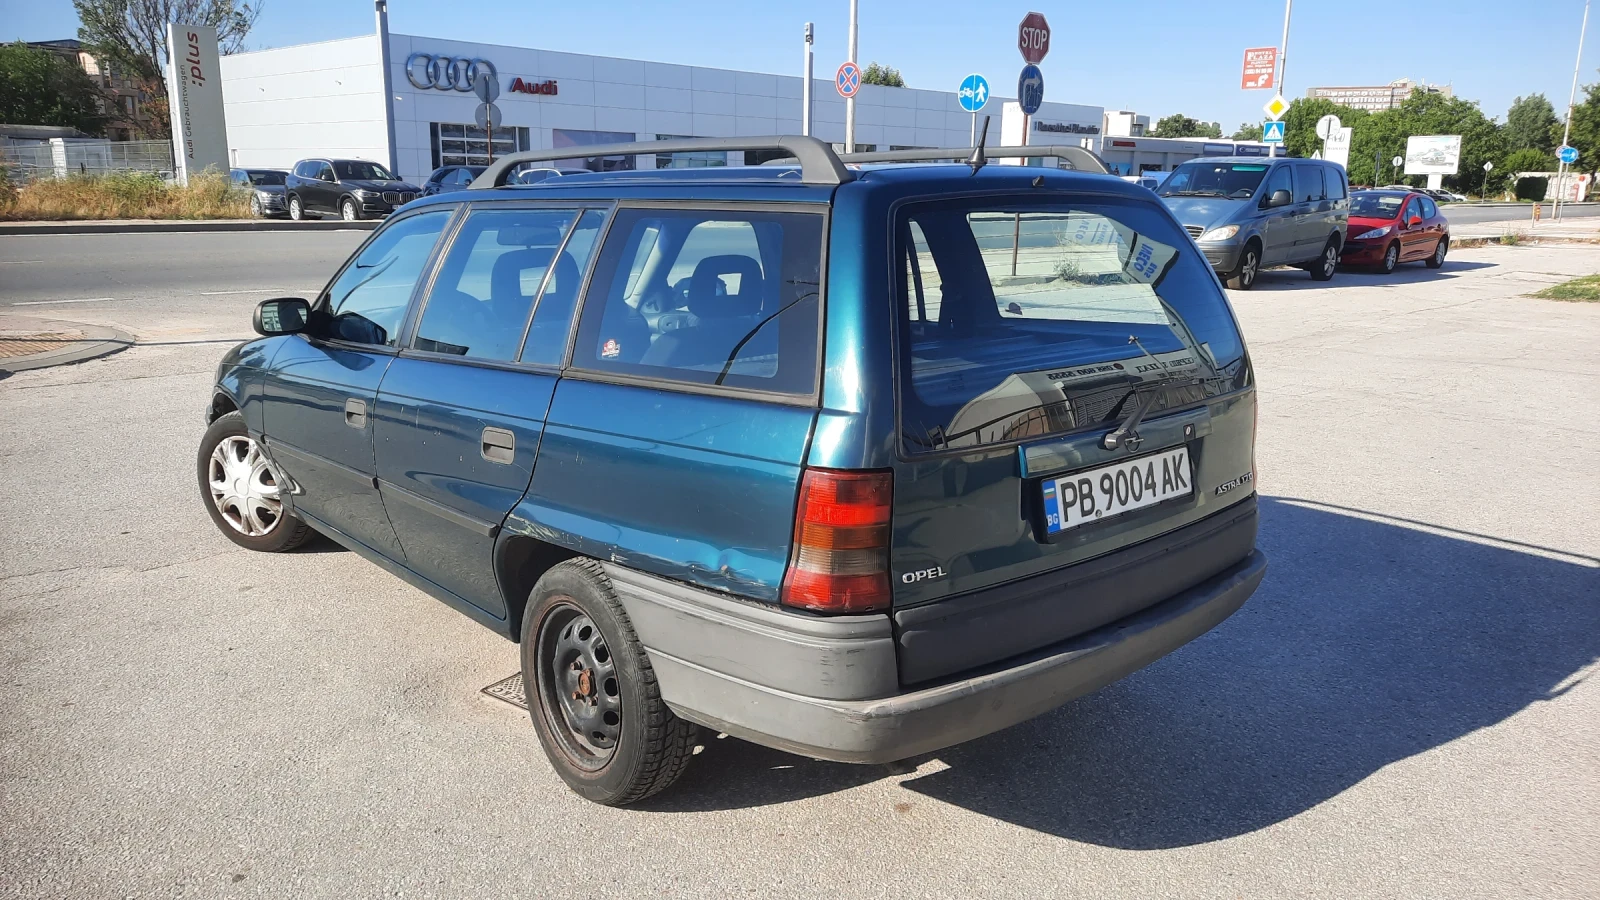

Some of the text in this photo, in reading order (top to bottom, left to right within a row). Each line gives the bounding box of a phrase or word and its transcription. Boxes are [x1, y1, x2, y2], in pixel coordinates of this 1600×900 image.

[1021, 26, 1048, 50] STOP
[509, 77, 558, 96] Audi
[180, 64, 194, 160] Audi Gebrauchtwagen
[1060, 453, 1188, 523] PB 9004 AK
[1215, 479, 1241, 496] ASTRA
[1047, 513, 1059, 525] BG
[902, 566, 947, 584] OPEL
